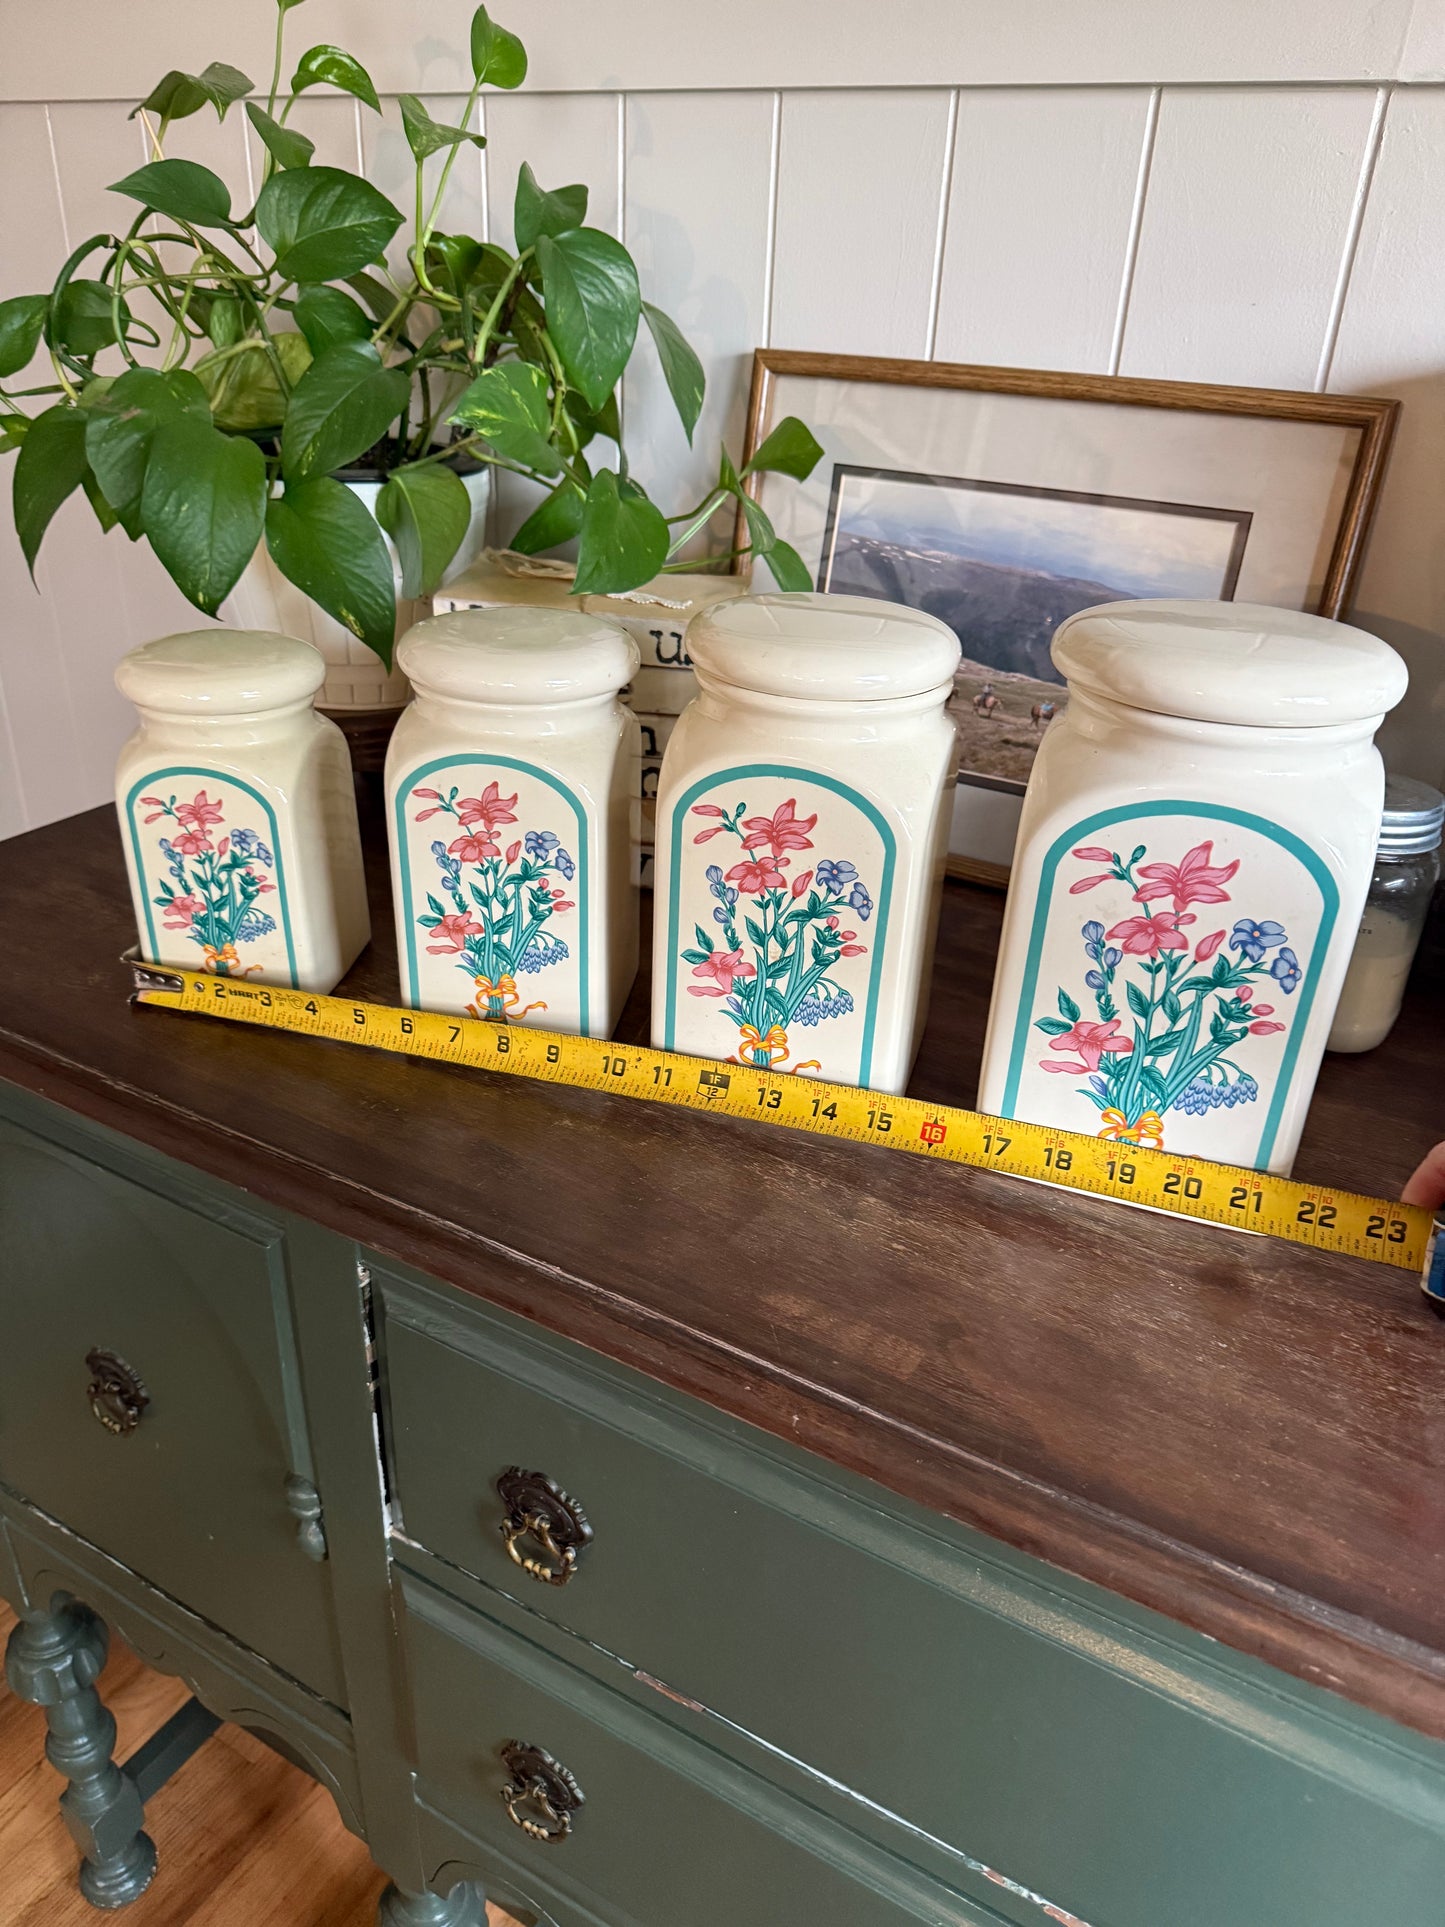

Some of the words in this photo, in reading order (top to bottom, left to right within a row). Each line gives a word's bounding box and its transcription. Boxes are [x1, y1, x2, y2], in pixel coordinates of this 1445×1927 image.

[213, 982, 227, 999] 2
[259, 991, 272, 1007] 3
[304, 1000, 319, 1016] 4
[353, 1008, 366, 1025] 5
[400, 1017, 414, 1034] 6
[447, 1025, 461, 1043] 7
[496, 1035, 511, 1053] 8
[546, 1044, 560, 1063] 9
[602, 1055, 627, 1077] 10
[653, 1066, 673, 1087] 11
[706, 1086, 719, 1097] 12
[757, 1087, 783, 1110] 13
[811, 1098, 838, 1121] 14
[867, 1110, 894, 1132] 15
[923, 1126, 943, 1141] 16
[982, 1134, 1012, 1156] 17
[1043, 1147, 1073, 1171] 18
[1106, 1160, 1136, 1185] 19
[1163, 1172, 1203, 1200] 20
[1229, 1186, 1264, 1213] 21
[1297, 1200, 1338, 1229] 22
[1365, 1215, 1408, 1243] 23
